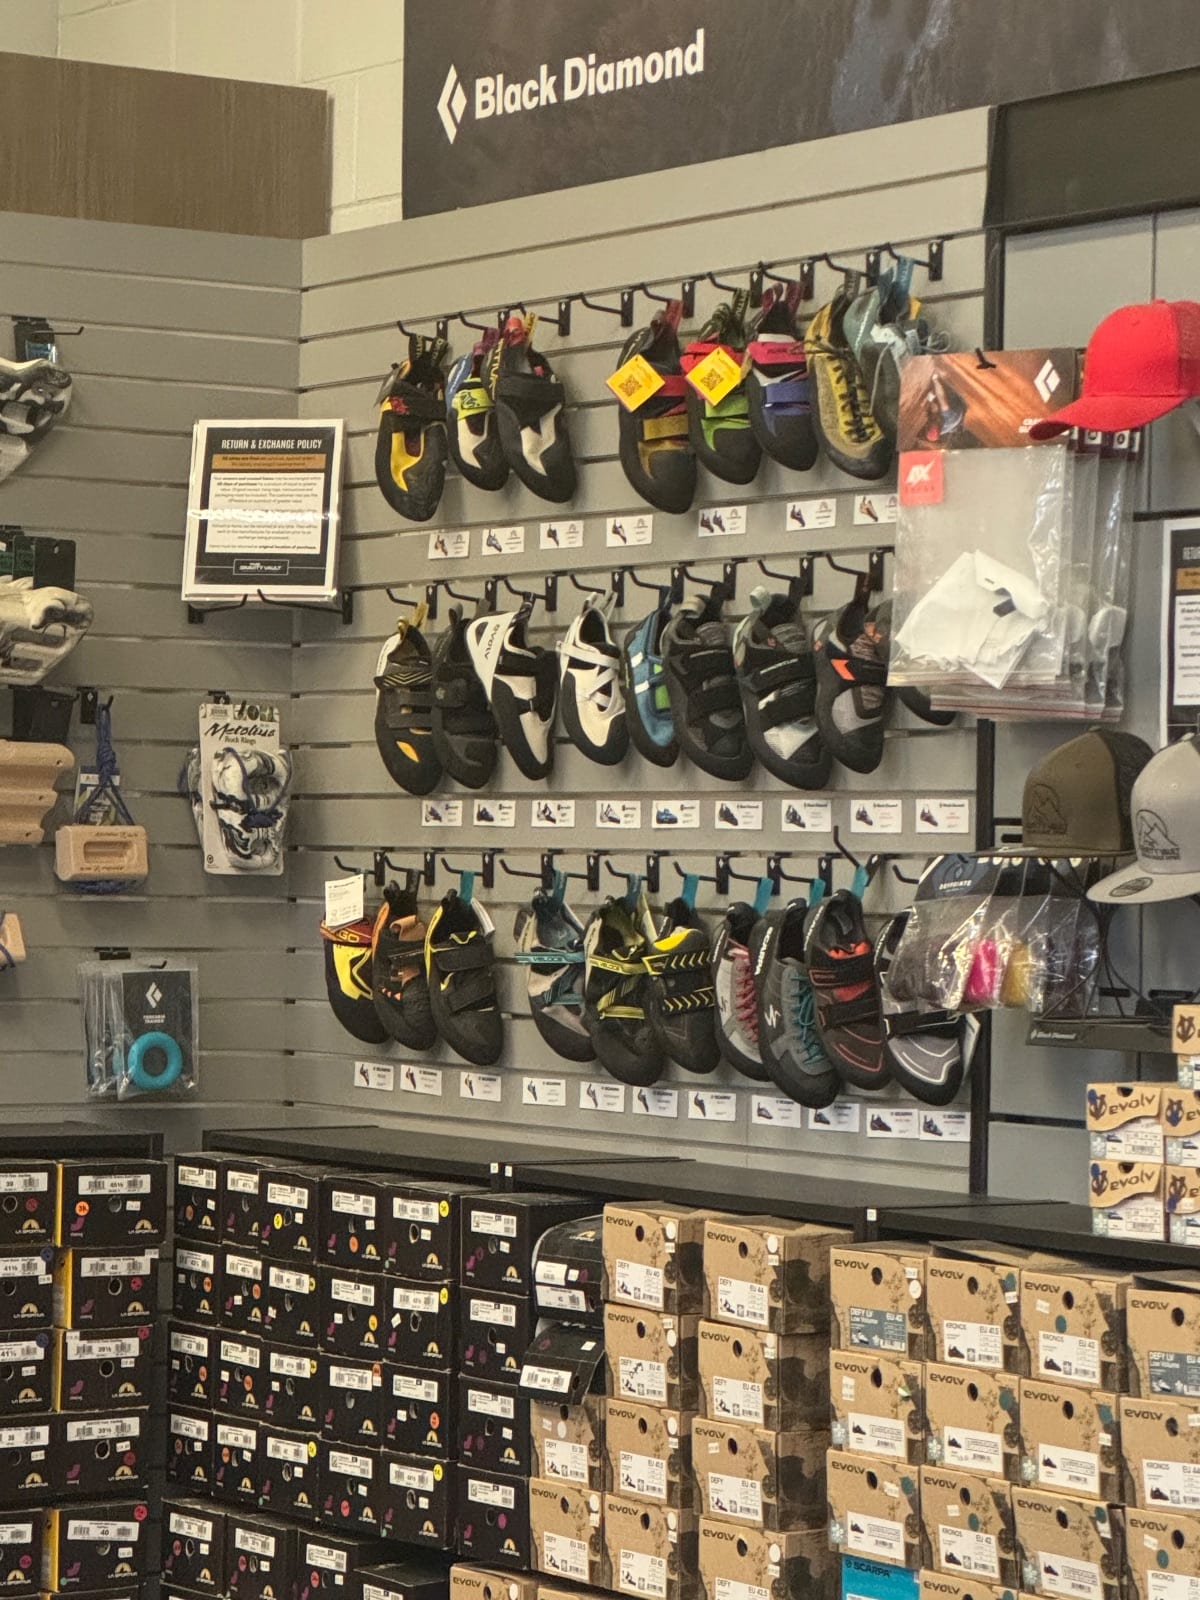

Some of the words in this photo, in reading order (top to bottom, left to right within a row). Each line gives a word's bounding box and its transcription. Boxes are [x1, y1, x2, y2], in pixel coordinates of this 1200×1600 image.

[475, 65, 557, 120] Black
[564, 28, 705, 101] Diamond
[221, 439, 249, 449] RETURN
[250, 439, 257, 449] &
[258, 439, 295, 449] EXCHANGE
[297, 439, 323, 449] POLICY
[204, 722, 276, 740] Metolius
[1109, 1093, 1156, 1115] evolv
[1110, 1170, 1155, 1191] evolv
[605, 1215, 634, 1228] evolv
[707, 1230, 736, 1244] evolv
[834, 1259, 870, 1270] evolv
[930, 1268, 964, 1280] evolv
[720, 1278, 732, 1287] DEFY
[1024, 1281, 1061, 1294] evolv
[1131, 1299, 1170, 1311] evolv
[607, 1312, 635, 1324] evolv
[701, 1331, 731, 1343] evolv
[834, 1361, 869, 1374] evolv
[929, 1373, 965, 1386] evolv
[1024, 1390, 1060, 1403] evolv
[608, 1407, 637, 1420] evolv
[1124, 1408, 1163, 1421] evolv
[695, 1427, 726, 1440] evolv
[832, 1461, 865, 1475] evolv
[710, 1476, 724, 1485] DEFY
[924, 1476, 957, 1489] evolv
[531, 1487, 558, 1500] evolv
[608, 1505, 639, 1517] evolv
[1017, 1499, 1053, 1513] evolv
[1129, 1518, 1169, 1532] evolv
[703, 1528, 736, 1542] evolv
[853, 1560, 893, 1578] SCARPA
[452, 1577, 482, 1589] evolv
[717, 1578, 731, 1587] DEFY
[923, 1580, 960, 1595] evolv
